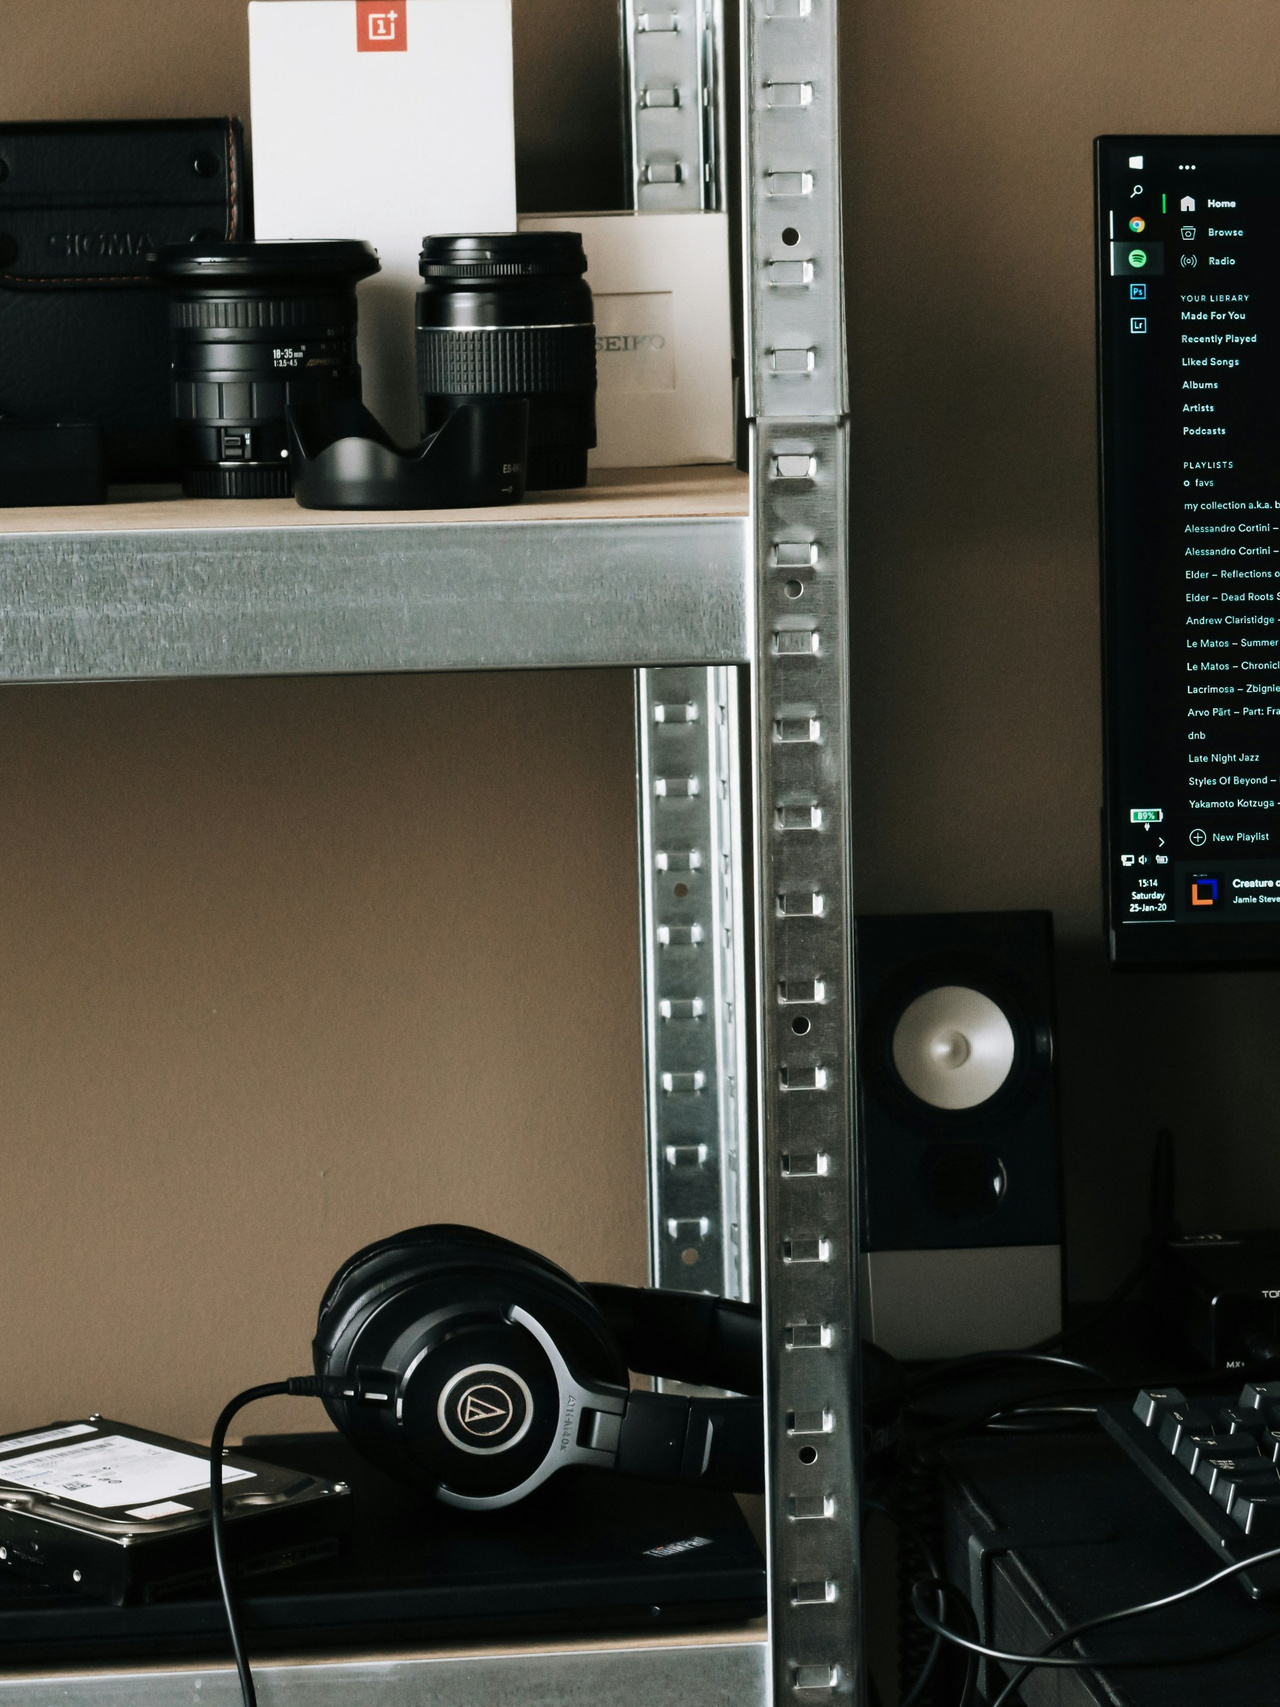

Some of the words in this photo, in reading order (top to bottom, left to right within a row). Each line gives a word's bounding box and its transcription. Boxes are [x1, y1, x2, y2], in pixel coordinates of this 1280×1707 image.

[1207, 198, 1237, 209] Home
[1208, 227, 1244, 237] Browse
[48, 232, 155, 258] SIGMA
[1208, 256, 1236, 266] Radio
[1180, 294, 1207, 303] YOUR
[1209, 294, 1250, 303] LIBRARY
[1181, 311, 1209, 321] Made
[1210, 311, 1227, 320] For
[1227, 311, 1246, 320] You
[1181, 334, 1224, 345] Recently
[1225, 333, 1257, 345] Played
[1181, 357, 1208, 367] Liked
[1209, 357, 1240, 368] Songs
[1181, 380, 1219, 390] Albums
[1182, 403, 1215, 413] Artists
[1182, 426, 1226, 436] Podcasts
[1183, 461, 1234, 470] PLAYLISTS
[1194, 478, 1214, 487] favs
[1184, 524, 1236, 533] Alessandro
[1237, 523, 1270, 533] Cortini
[1187, 730, 1206, 740] dnb
[1188, 753, 1209, 763] Late
[1211, 753, 1237, 765] Night
[1238, 753, 1260, 762] Jazz
[1188, 776, 1217, 788] Styles
[1218, 775, 1231, 786] Of
[1233, 775, 1268, 787] Beyond
[1212, 832, 1235, 842] New
[1236, 832, 1270, 843] Playlist
[1138, 878, 1159, 888] 15:14
[1232, 878, 1274, 889] Creature
[1131, 891, 1166, 902] Saturday
[1232, 895, 1258, 904] Jamie
